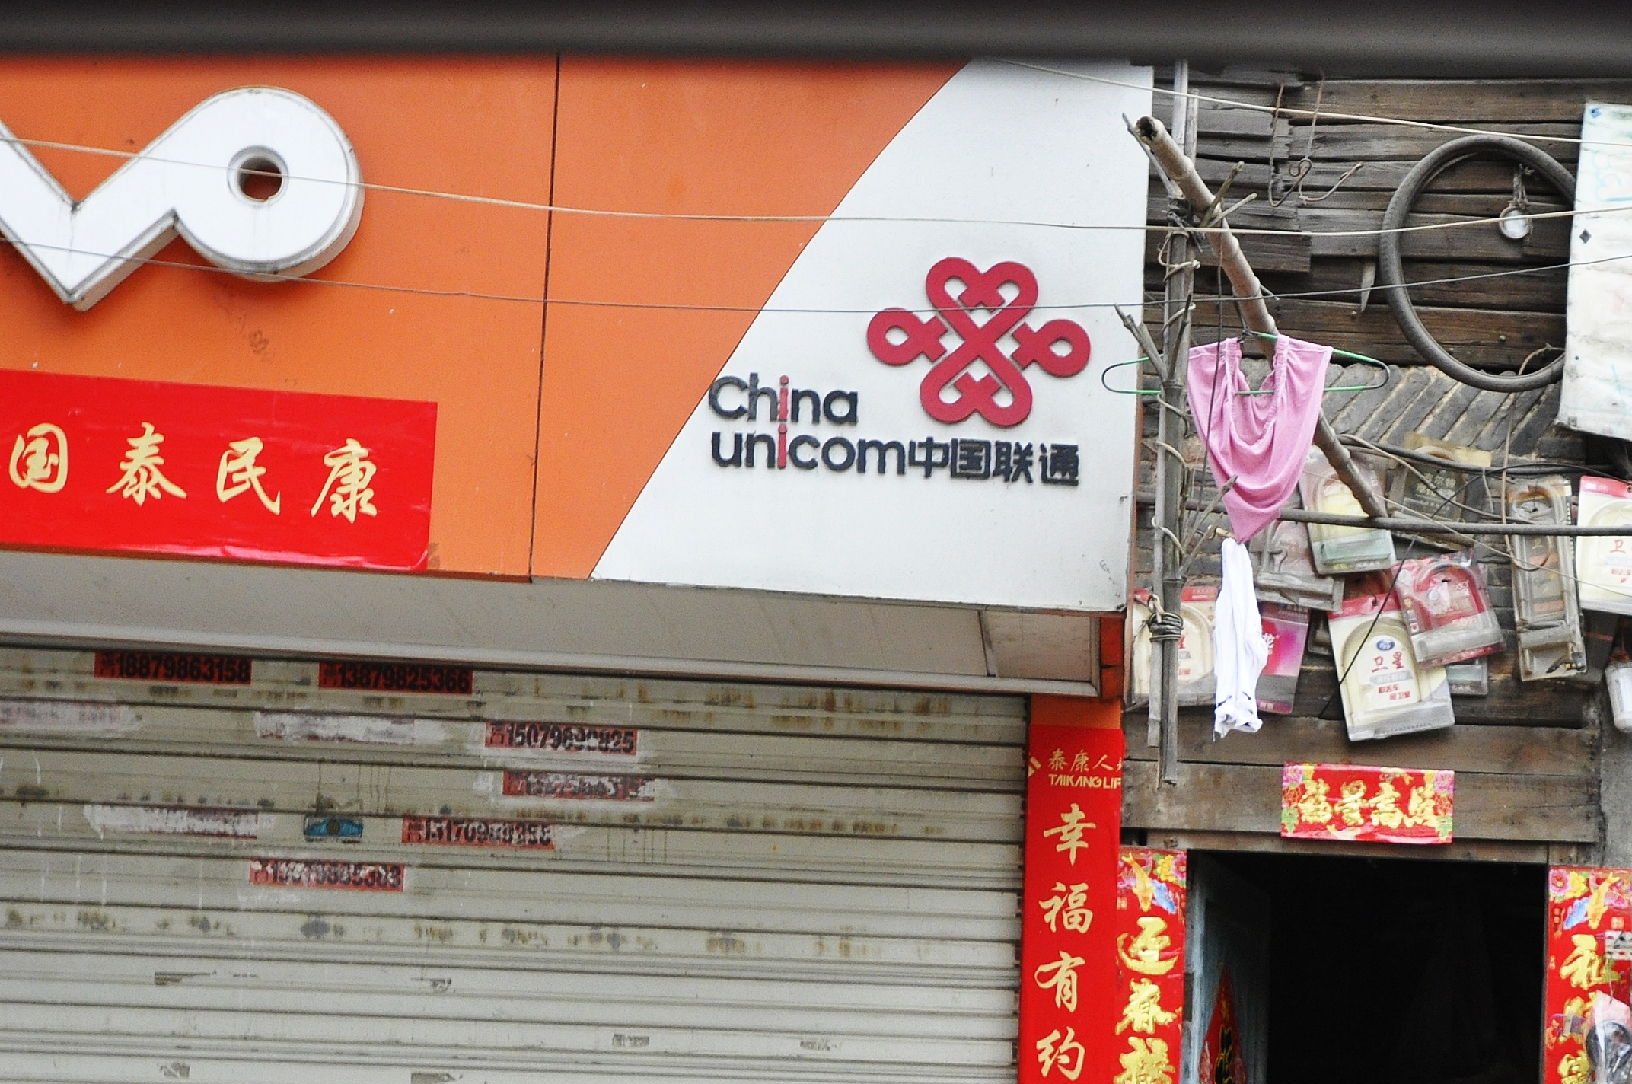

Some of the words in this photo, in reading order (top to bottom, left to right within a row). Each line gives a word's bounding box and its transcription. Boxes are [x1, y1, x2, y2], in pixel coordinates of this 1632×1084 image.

[708, 371, 859, 426] China
[8, 420, 380, 525] 国泰民康
[711, 423, 906, 477] unicom
[907, 435, 1081, 487] 中国联通
